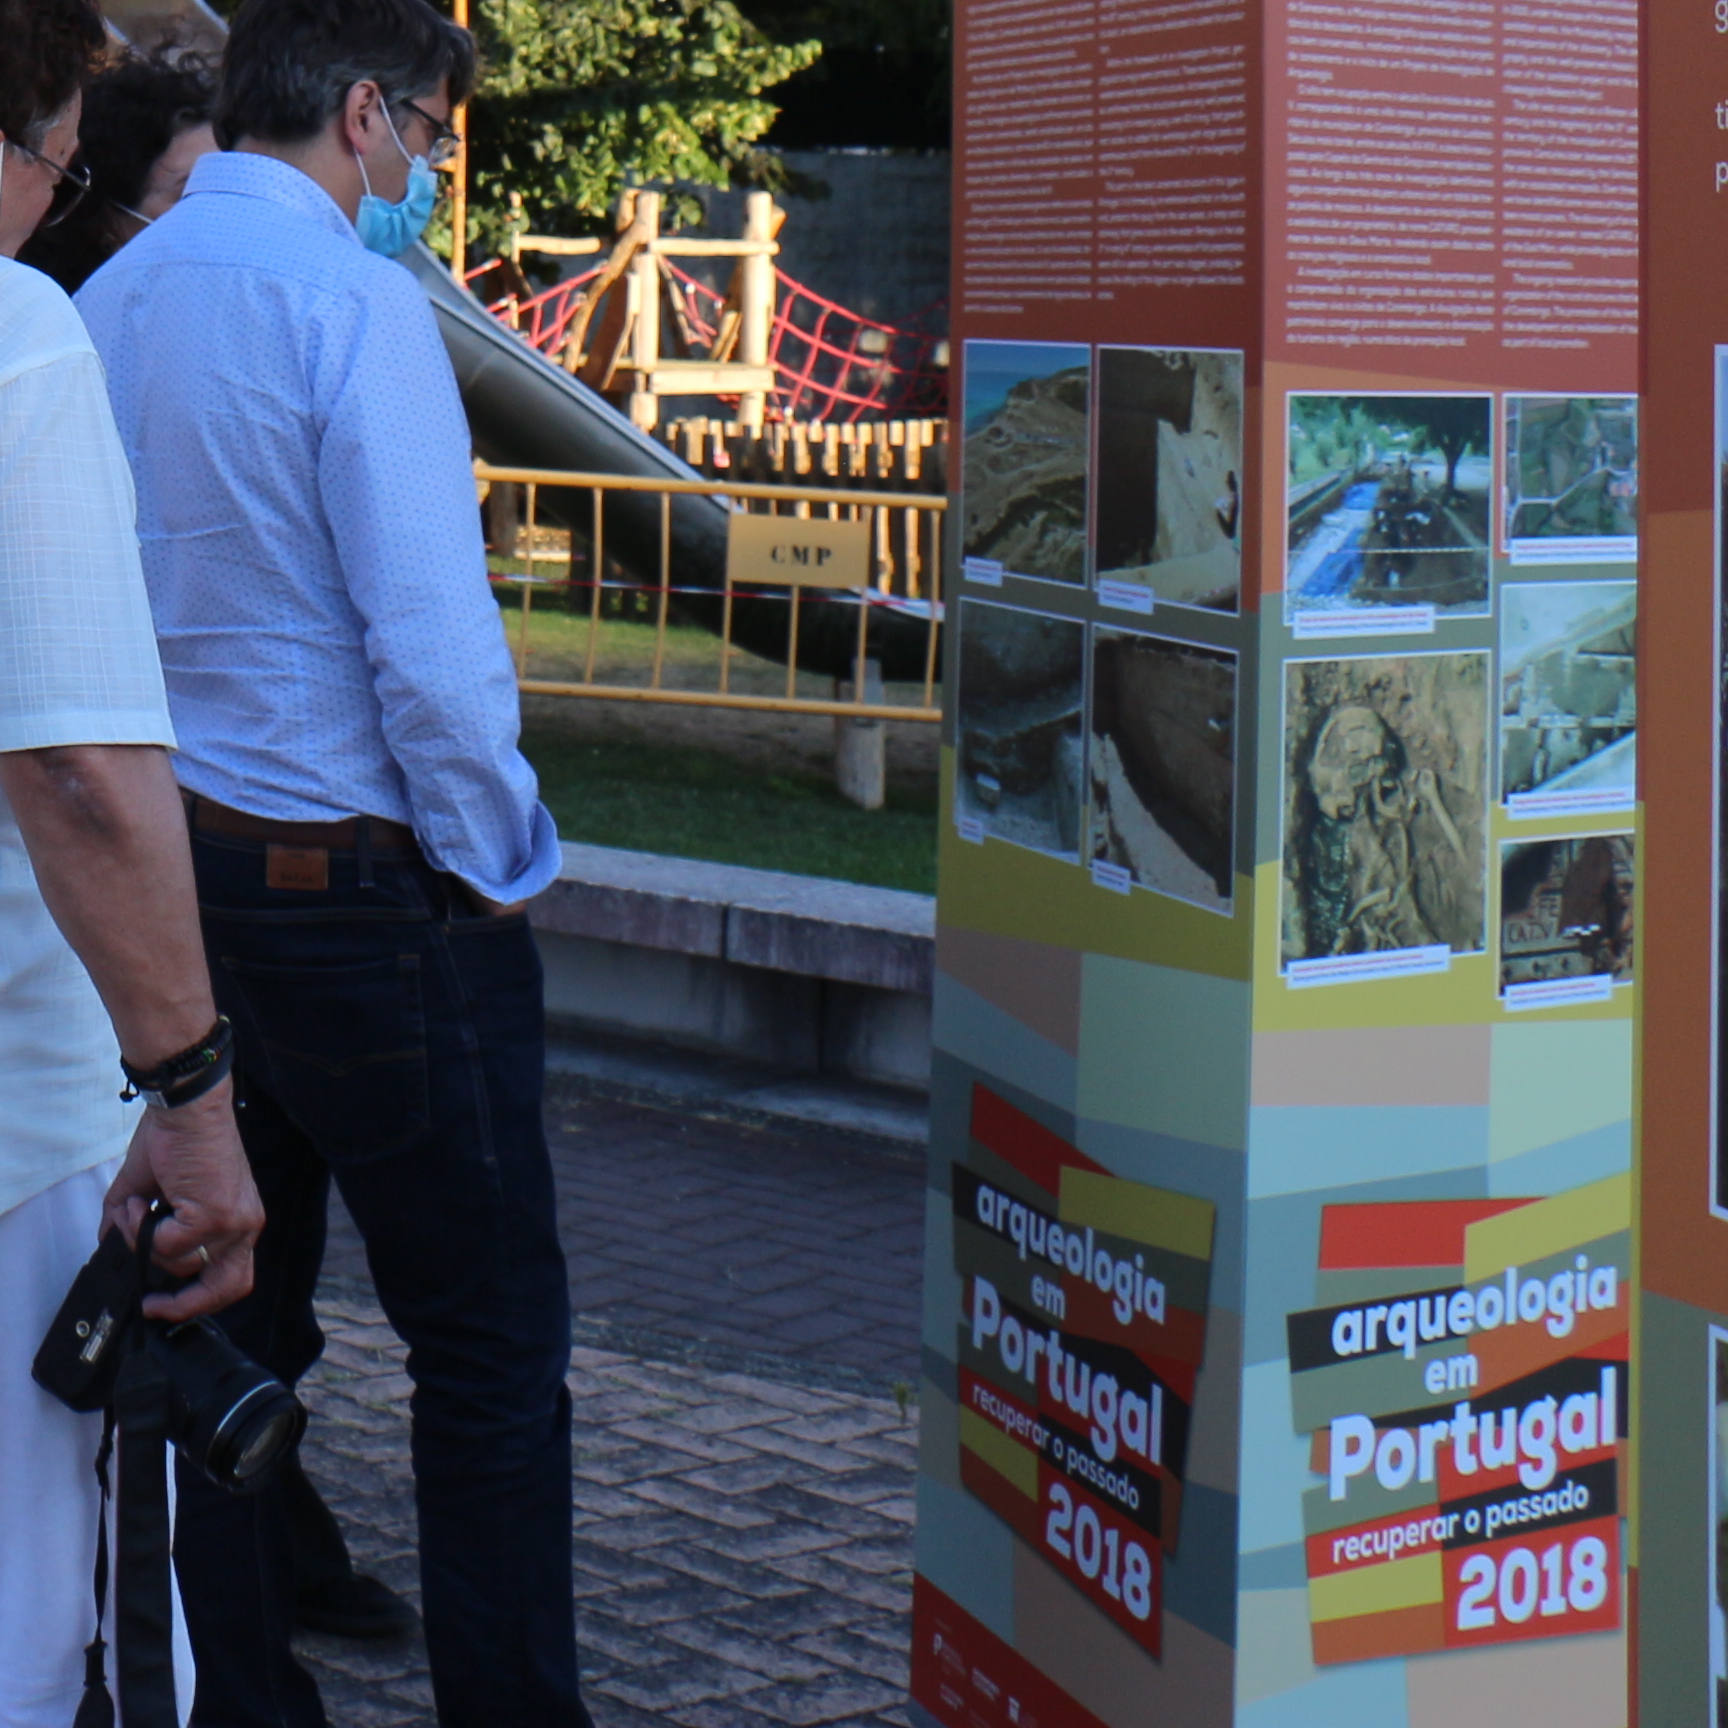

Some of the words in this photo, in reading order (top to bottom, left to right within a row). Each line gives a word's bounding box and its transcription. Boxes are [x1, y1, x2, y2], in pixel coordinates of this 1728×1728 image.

[770, 544, 833, 566] CMP
[975, 1181, 1166, 1326] arqueologia
[1031, 1275, 1067, 1321] em
[1331, 1254, 1619, 1360] arqueologia
[971, 1275, 1164, 1467] Portugal
[1423, 1348, 1479, 1395] em
[971, 1381, 1050, 1455] recuperar
[1052, 1435, 1065, 1464] o
[1065, 1445, 1142, 1511] passado
[1327, 1368, 1619, 1502] Portugal
[1044, 1485, 1153, 1622] 2018
[1332, 1513, 1460, 1565] recuperar
[1463, 1507, 1482, 1533] o
[1484, 1481, 1590, 1541] passado
[1456, 1535, 1609, 1631] 2018
